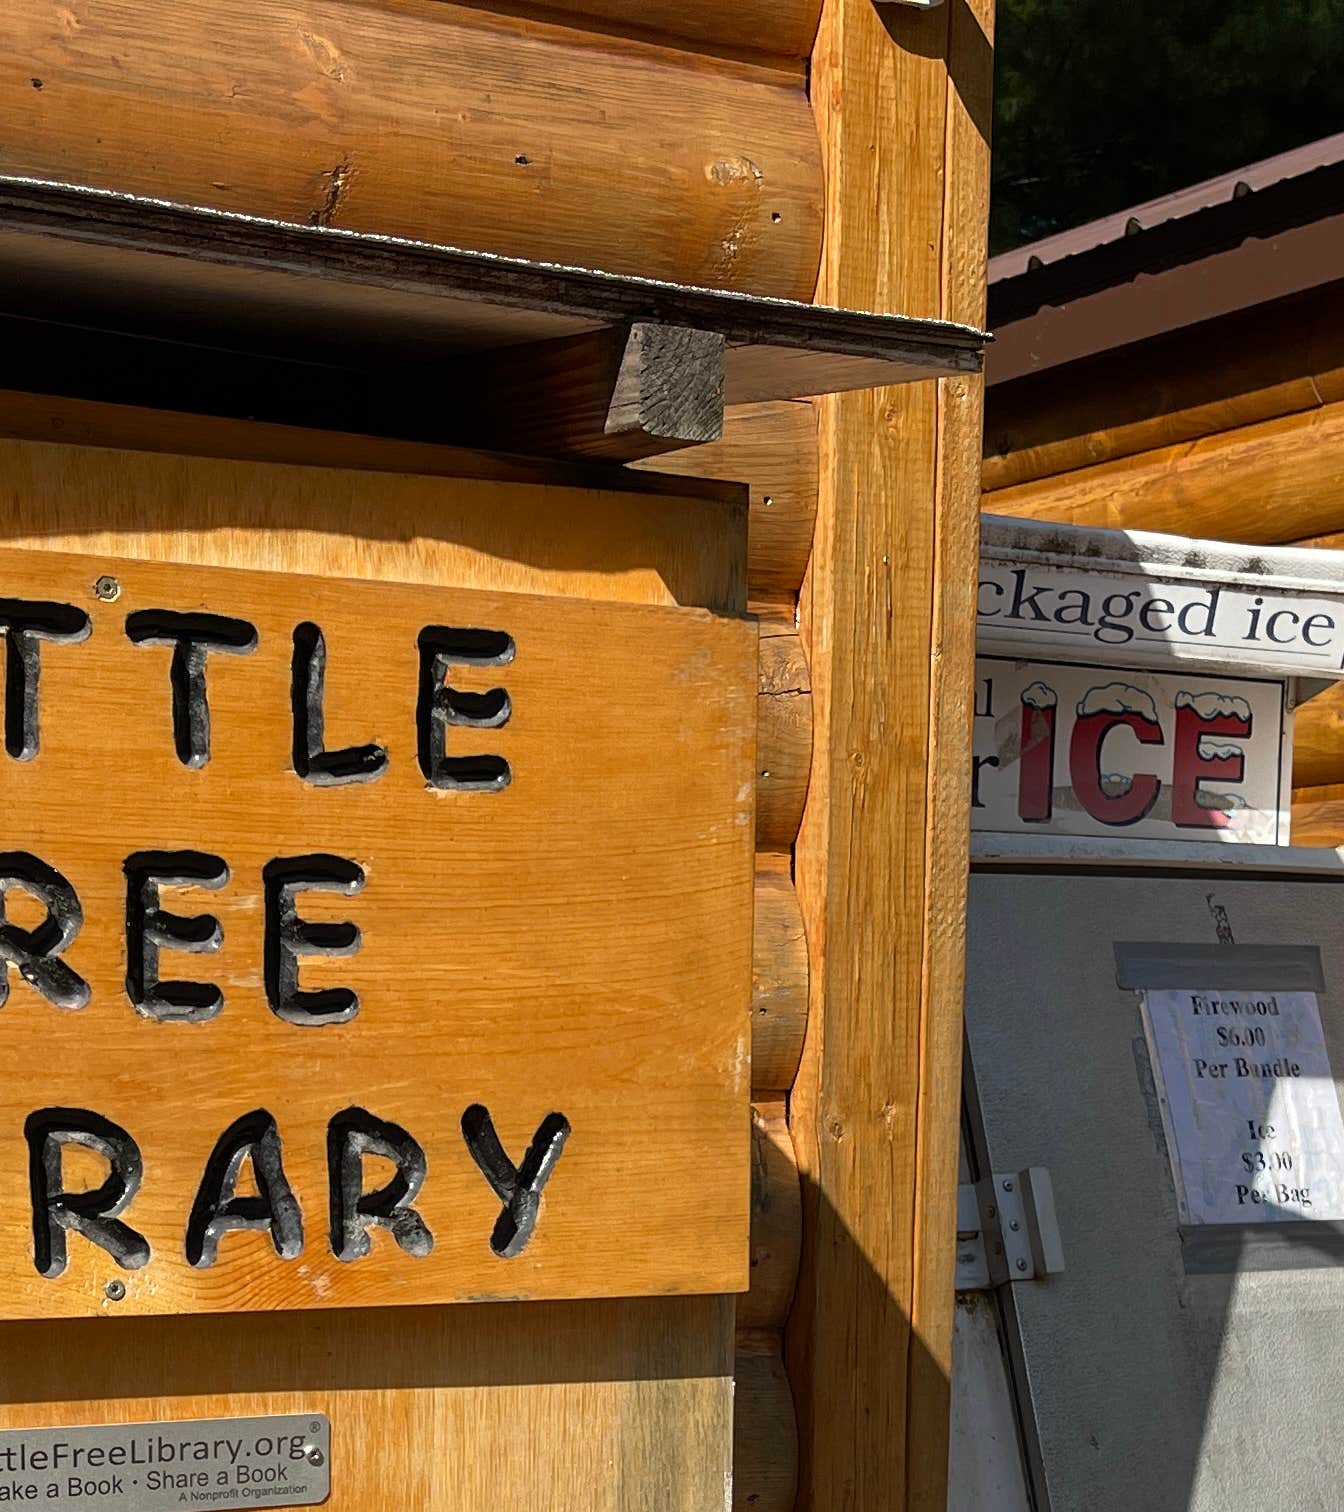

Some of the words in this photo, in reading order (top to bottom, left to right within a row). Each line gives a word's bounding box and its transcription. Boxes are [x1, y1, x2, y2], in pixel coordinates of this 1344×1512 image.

[1241, 597, 1335, 647] ice
[1017, 681, 1254, 828] ICE
[1189, 995, 1280, 1016] Firewood
[1216, 1026, 1266, 1048] $6.00
[1194, 1058, 1229, 1078] Per
[1247, 1119, 1277, 1141] Ice
[1274, 1183, 1313, 1207] Bag
[46, 1484, 60, 1499] a
[66, 1474, 124, 1498] Book
[146, 1468, 210, 1492] Share
[215, 1472, 229, 1487] a
[236, 1463, 289, 1485] Book
[178, 1491, 188, 1502] A
[190, 1487, 240, 1502] Nonprofit
[241, 1483, 308, 1499] Organization
